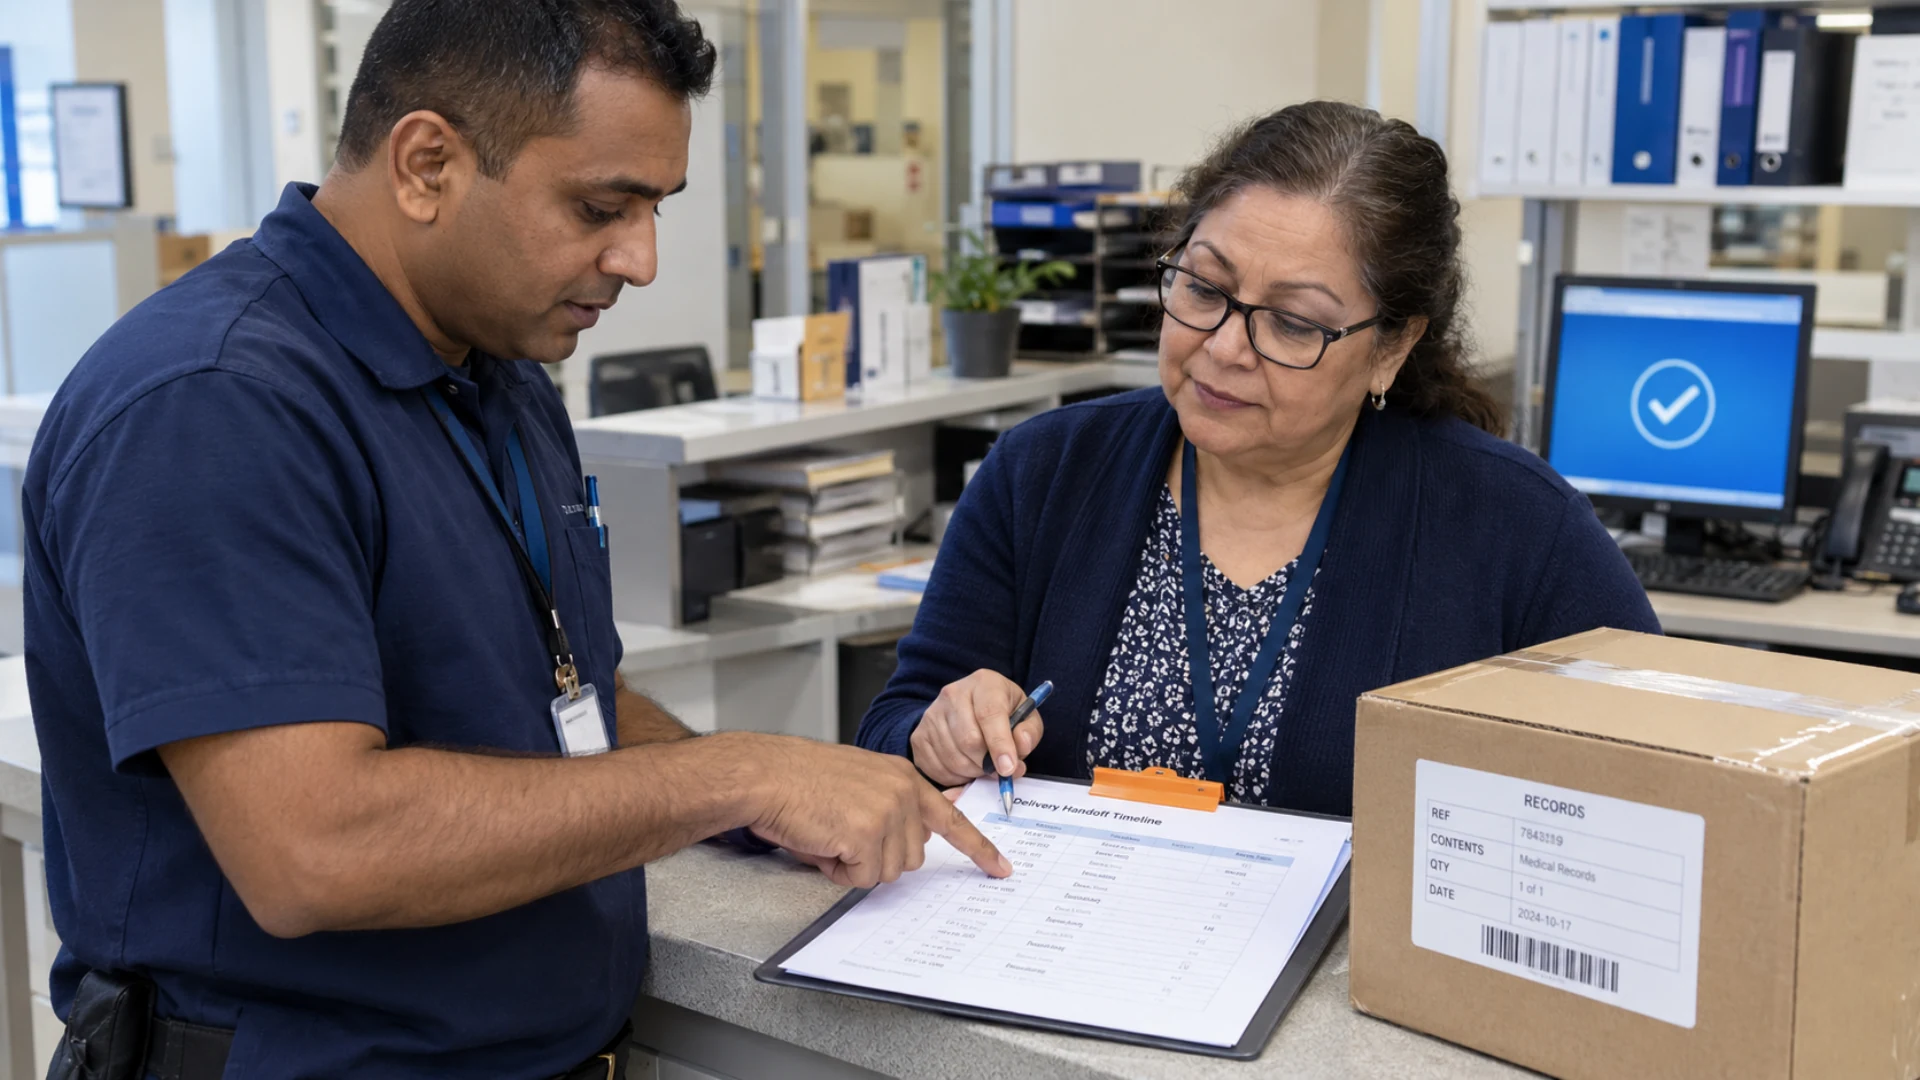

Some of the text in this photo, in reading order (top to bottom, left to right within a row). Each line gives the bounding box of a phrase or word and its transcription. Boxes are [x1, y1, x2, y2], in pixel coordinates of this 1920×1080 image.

[1013, 797, 1163, 826] Delivery Handoff Timeline
[1431, 807, 1451, 821] REF
[1524, 794, 1585, 819] RECORDS
[1430, 833, 1485, 855] CONTENTS
[1430, 859, 1450, 873] QTY
[1519, 854, 1596, 883] Medical Records
[1429, 884, 1455, 900] DATE
[1519, 882, 1544, 897] 1 of 1
[1517, 908, 1572, 931] 2024-10-17
